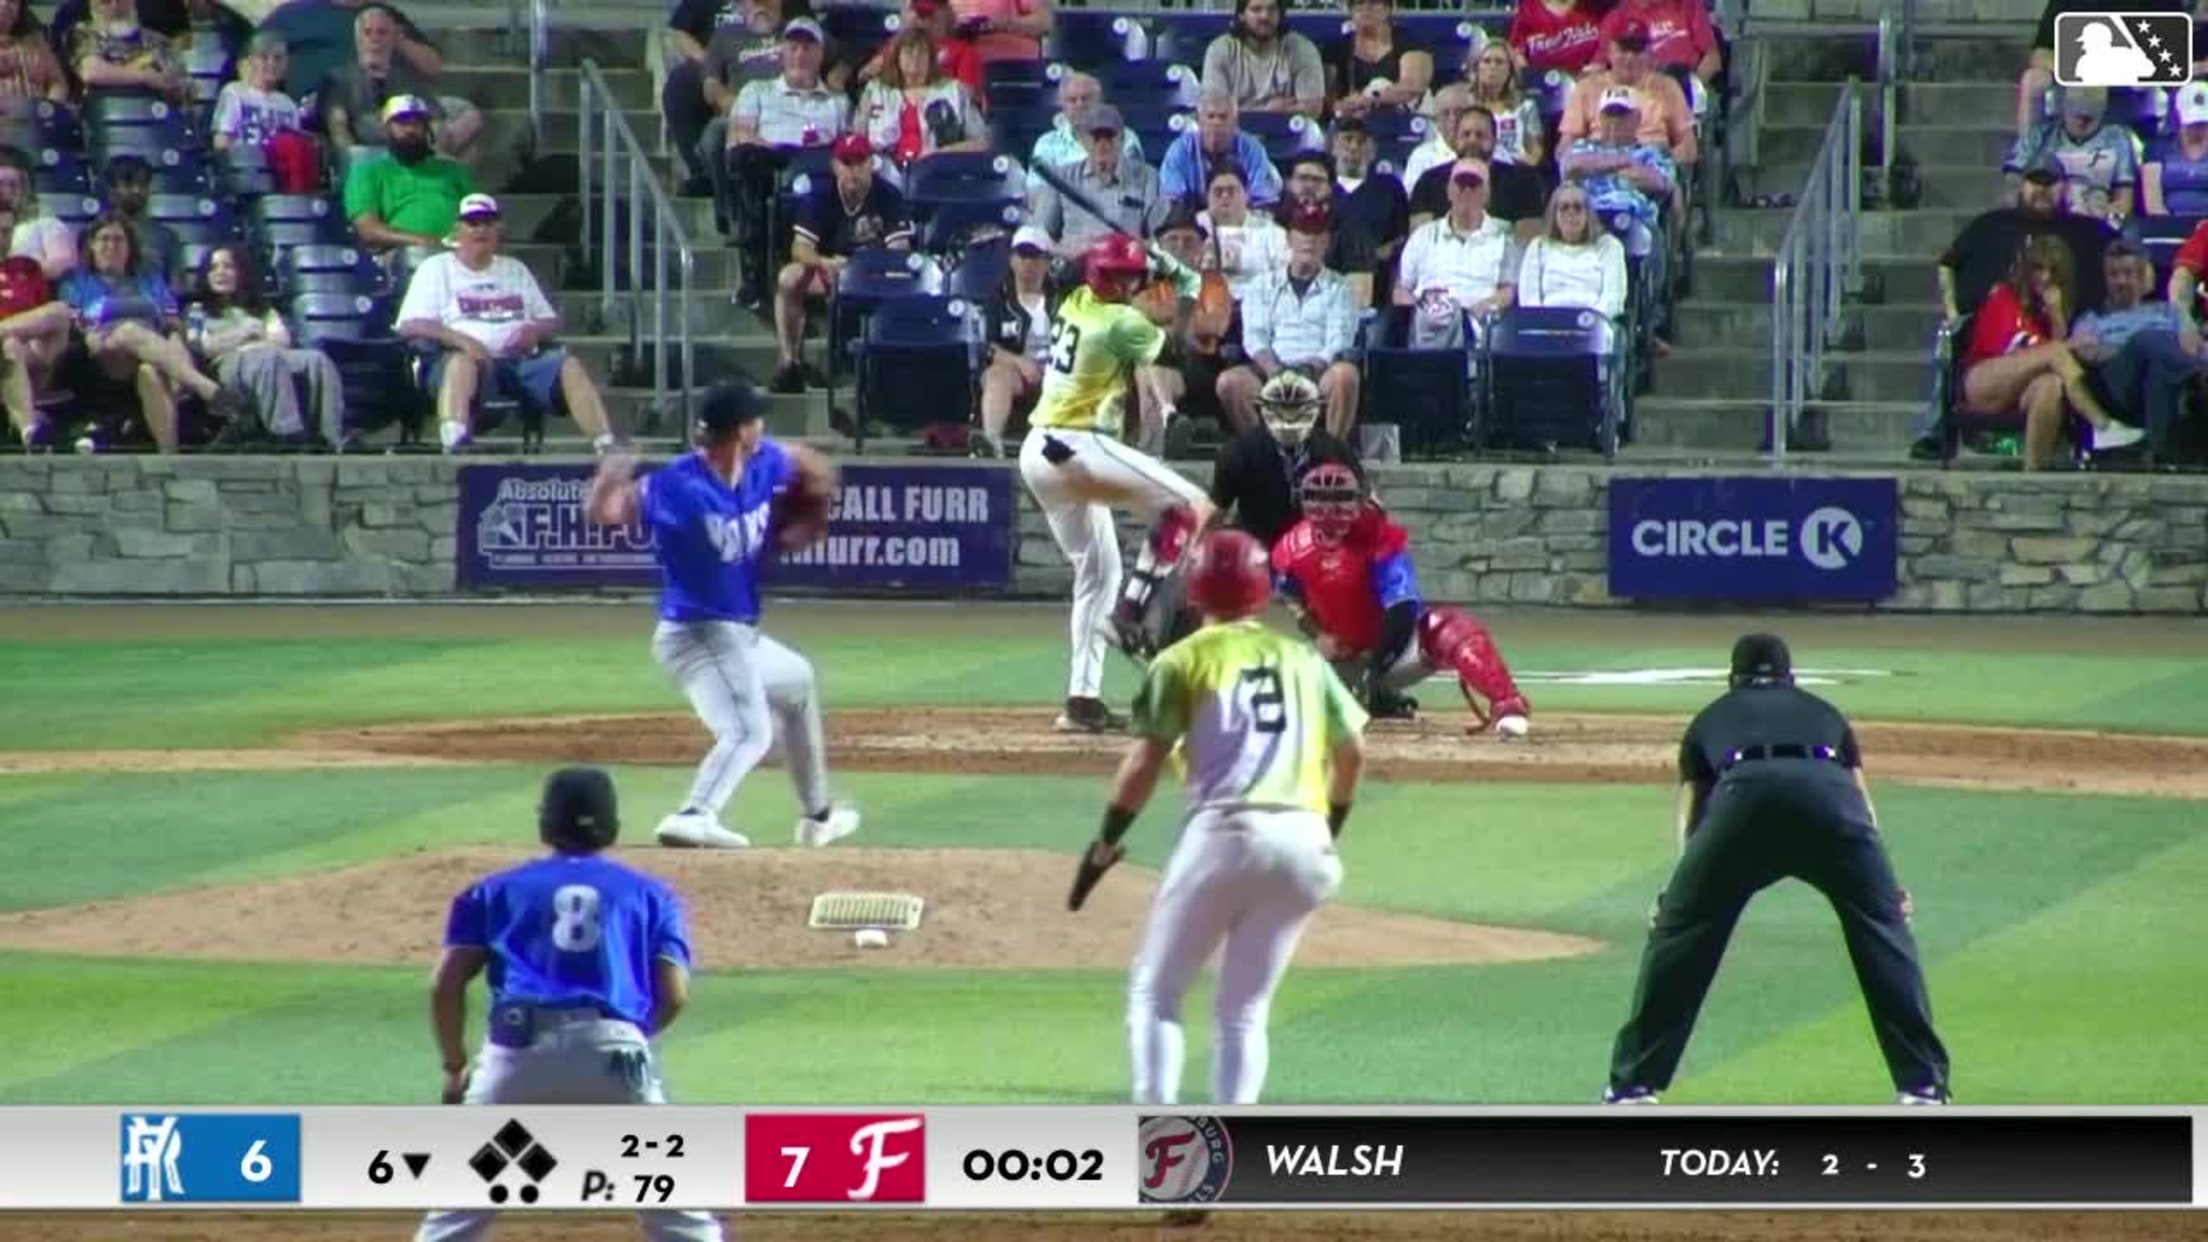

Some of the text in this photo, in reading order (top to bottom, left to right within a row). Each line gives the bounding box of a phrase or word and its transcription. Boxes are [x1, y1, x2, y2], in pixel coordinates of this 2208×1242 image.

[827, 486, 989, 523] CALL FURR
[1631, 519, 1789, 556] CIRCLE
[552, 884, 601, 952] 8
